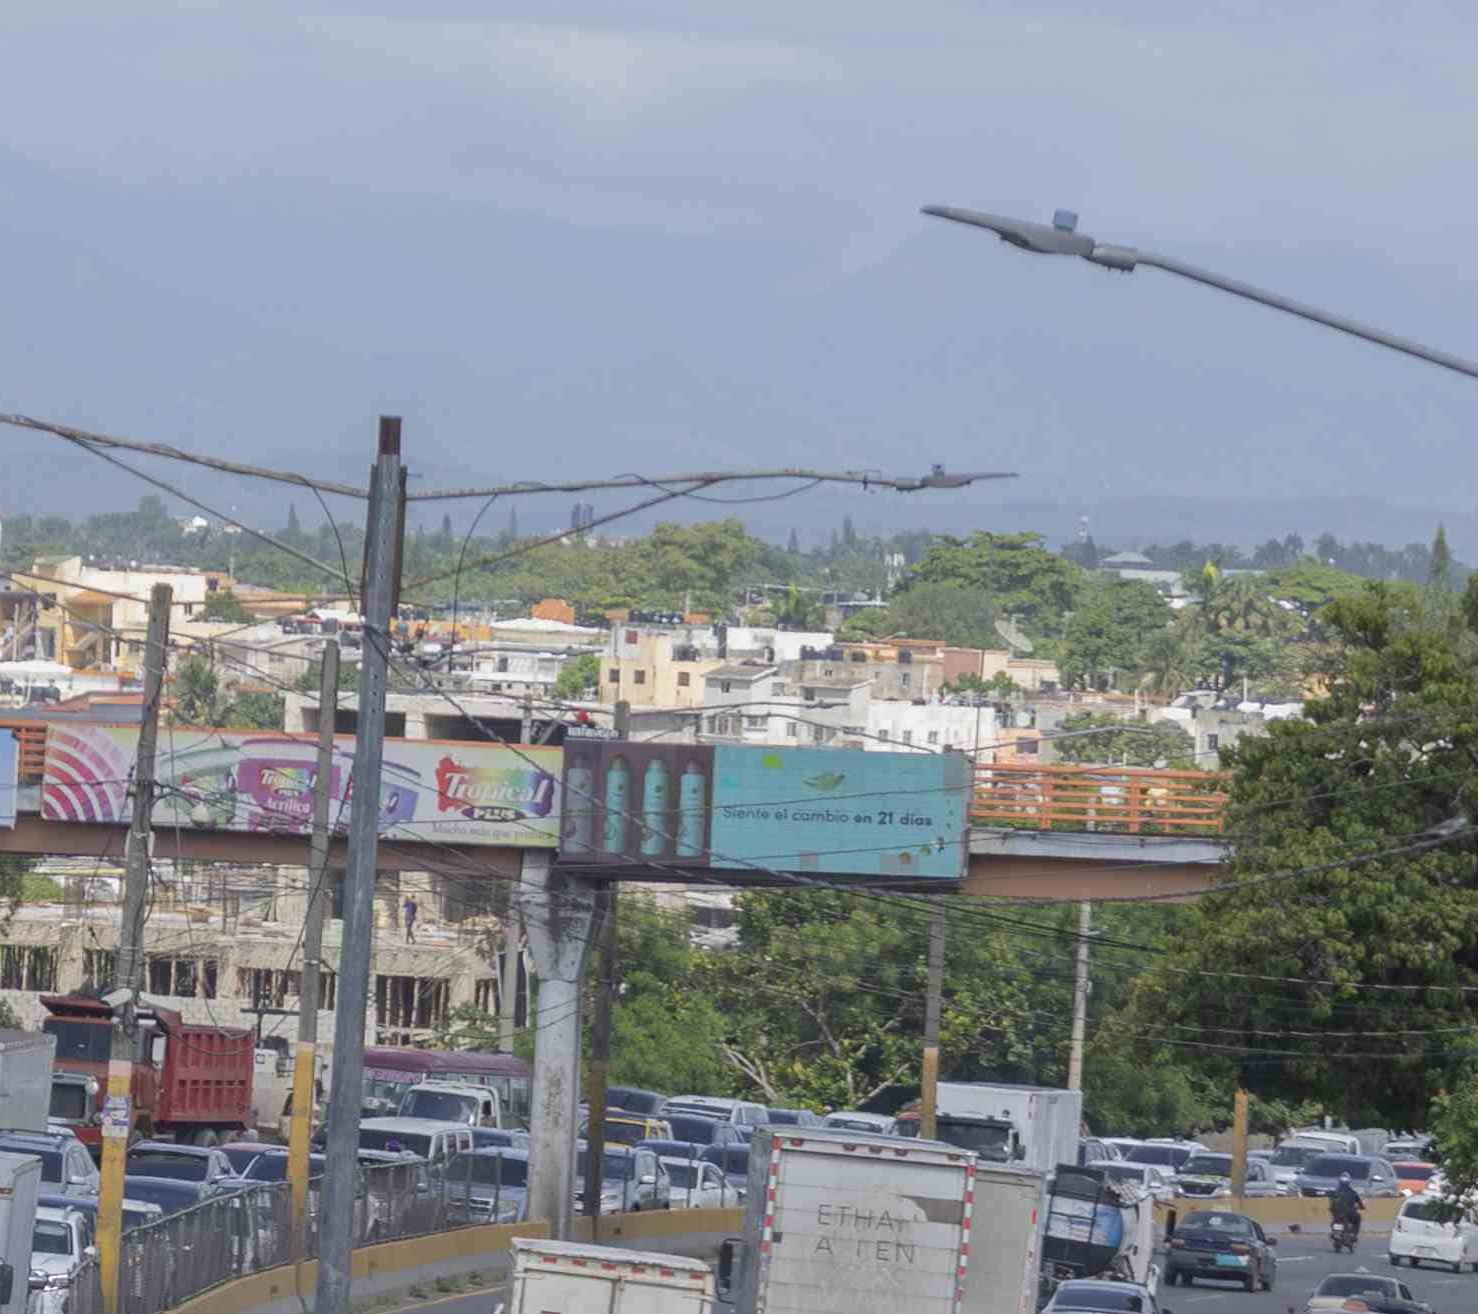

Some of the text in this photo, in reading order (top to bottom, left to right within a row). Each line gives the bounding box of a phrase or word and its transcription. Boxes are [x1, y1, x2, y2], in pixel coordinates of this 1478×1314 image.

[444, 772, 550, 803] Tropical
[474, 807, 517, 820] PLUS
[722, 806, 770, 821] Siente
[774, 808, 789, 822] el
[792, 809, 850, 824] cambio
[853, 814, 872, 825] en
[876, 811, 895, 826] 21
